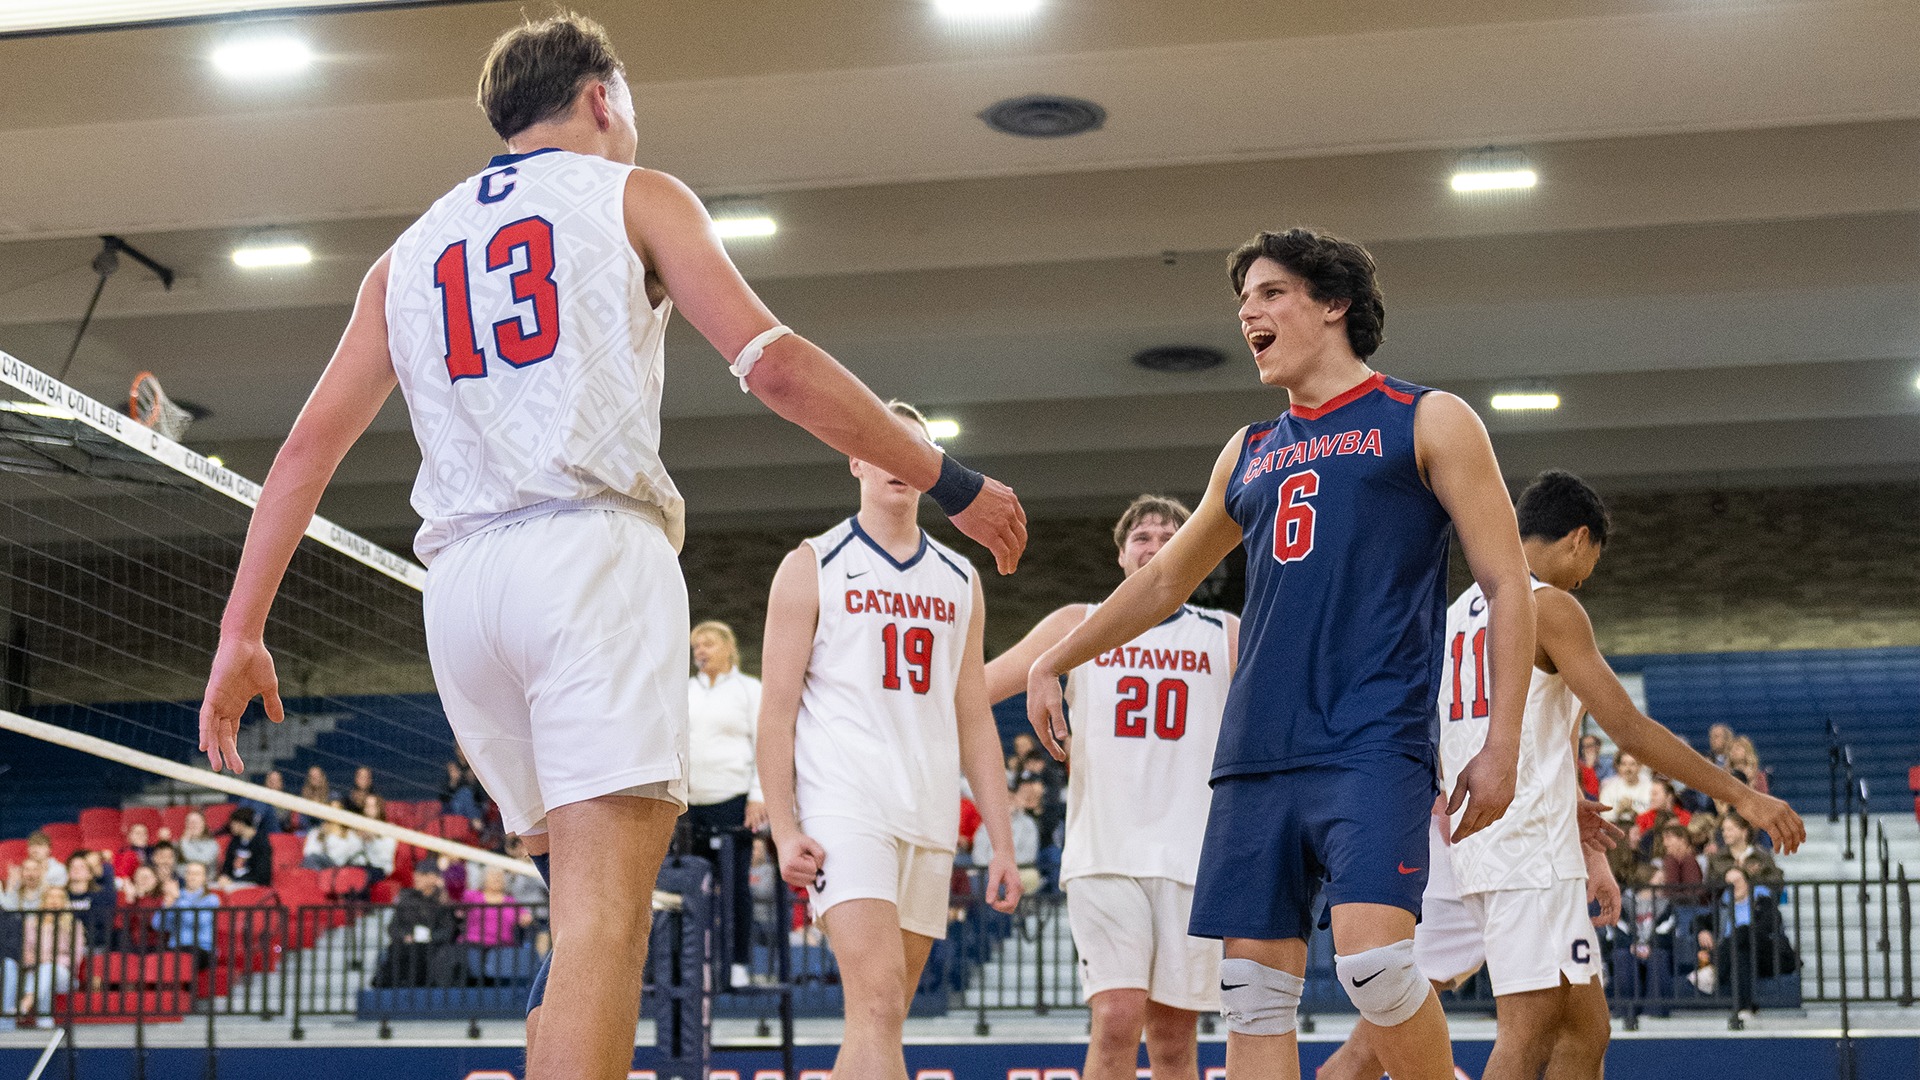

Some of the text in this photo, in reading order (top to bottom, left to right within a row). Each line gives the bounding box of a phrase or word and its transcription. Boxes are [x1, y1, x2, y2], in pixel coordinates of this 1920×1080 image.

[476, 164, 519, 207] C
[433, 214, 561, 386] 13
[2, 356, 63, 405] CATAWBA
[67, 391, 123, 434] COLLEGE
[1243, 428, 1383, 485] CATAWBA
[1272, 469, 1320, 565] 6
[844, 589, 956, 628] CATAWBA
[881, 622, 935, 695] 19
[1095, 646, 1211, 675] CATAWBA
[1449, 627, 1489, 722] 11
[1114, 675, 1189, 741] 20
[1570, 938, 1590, 964] C
